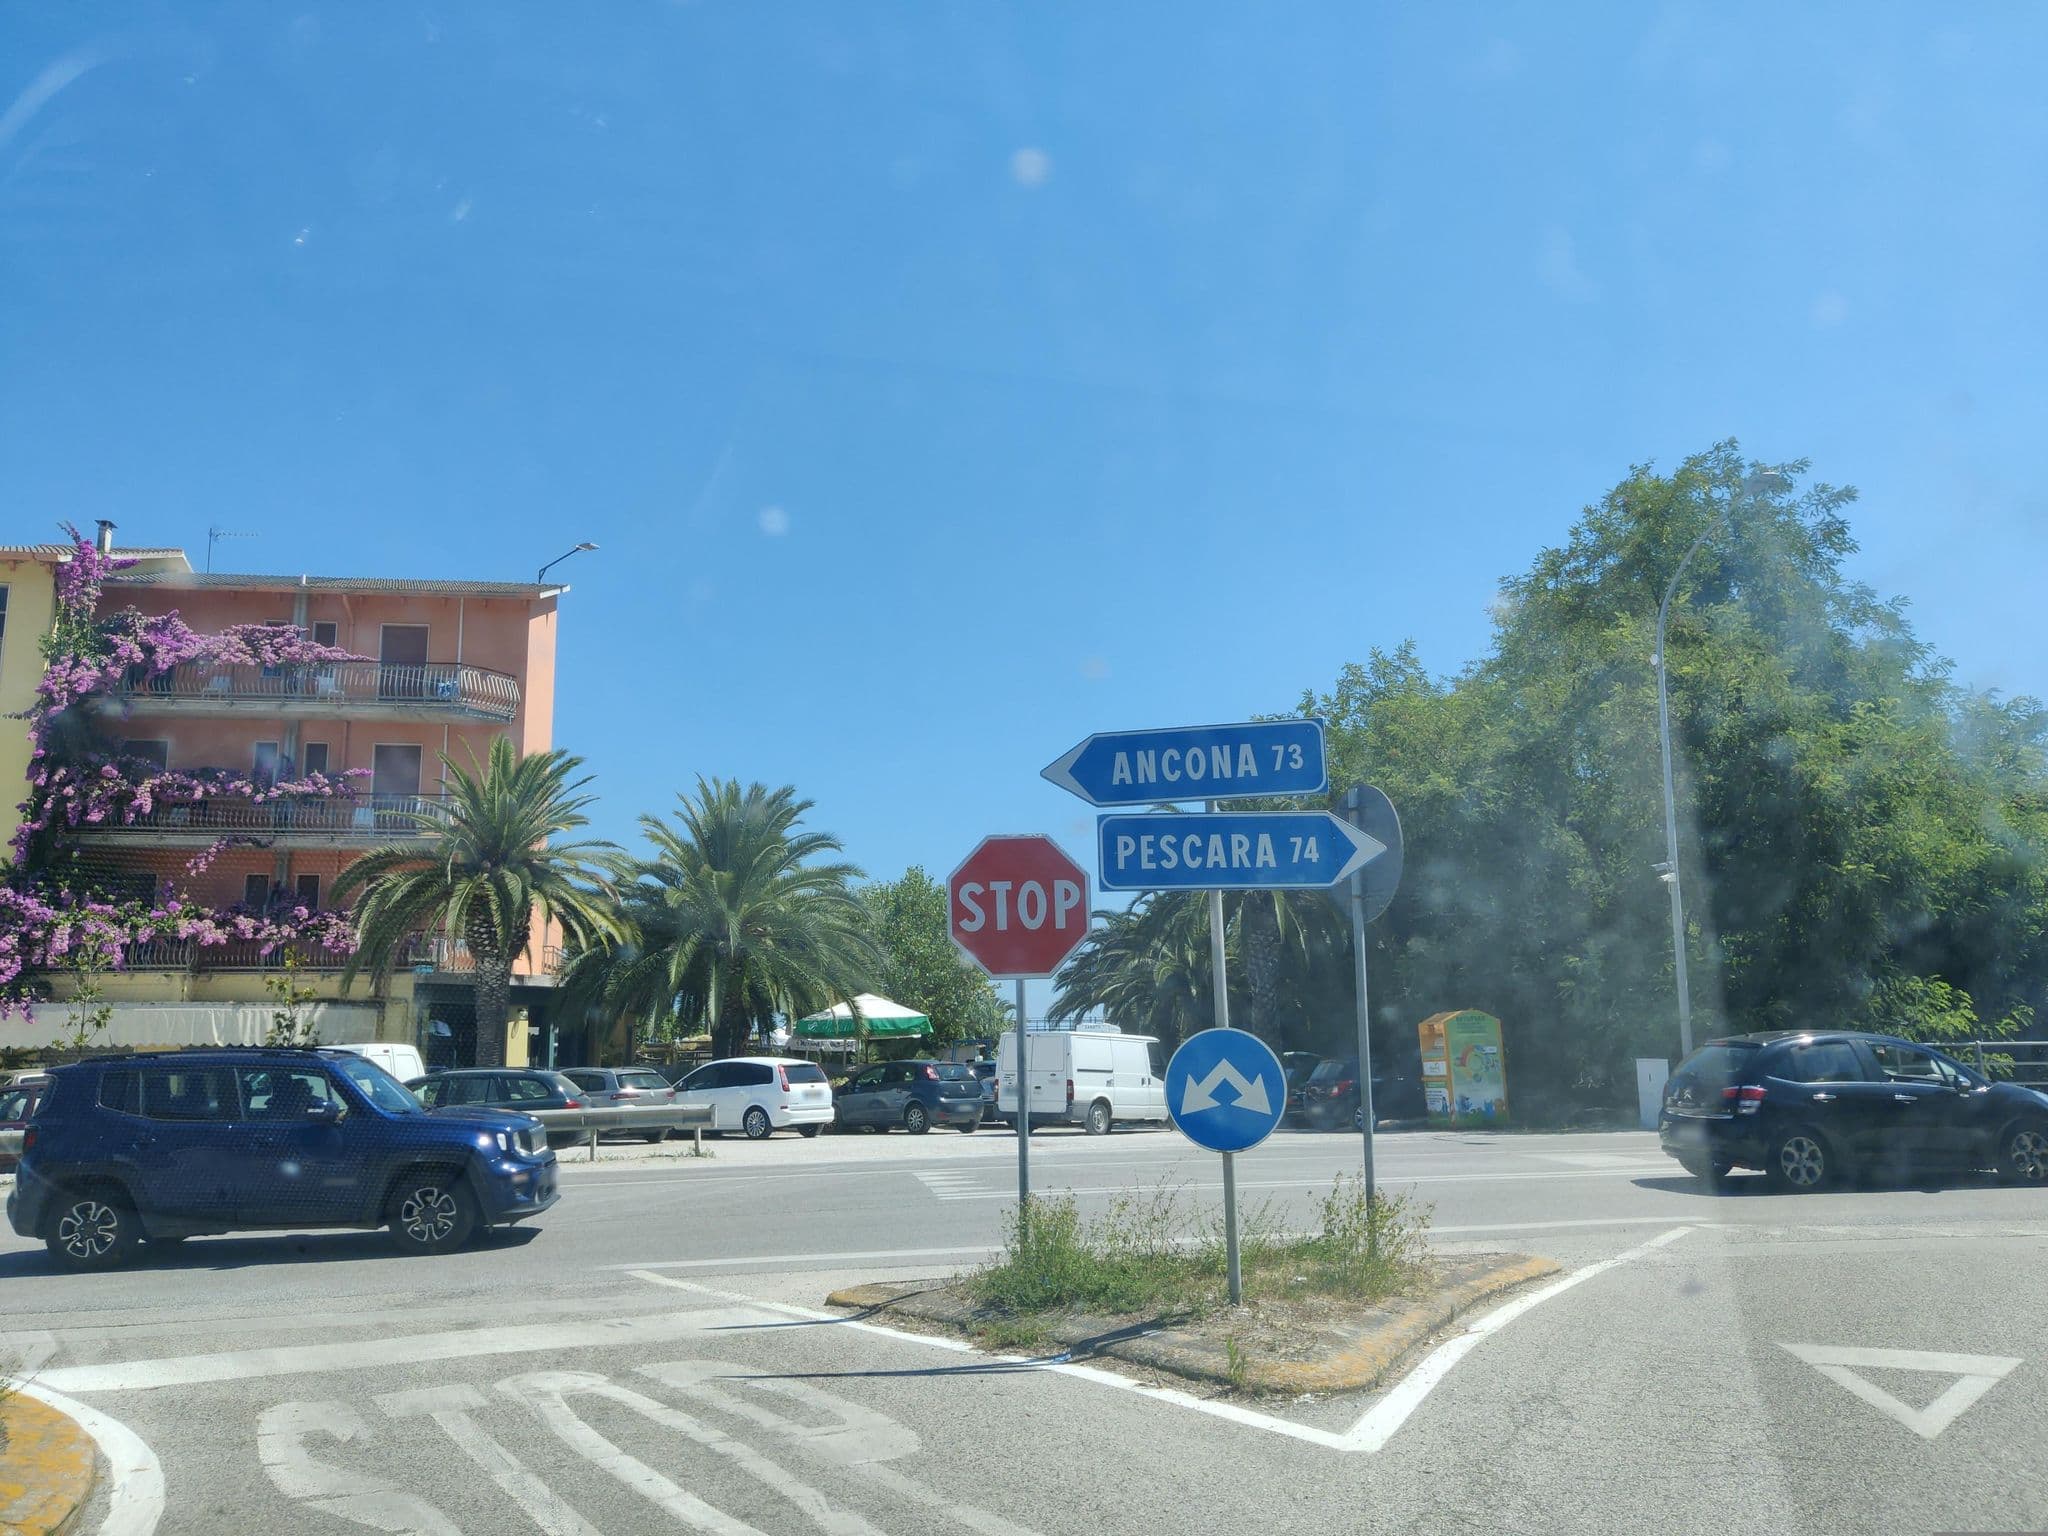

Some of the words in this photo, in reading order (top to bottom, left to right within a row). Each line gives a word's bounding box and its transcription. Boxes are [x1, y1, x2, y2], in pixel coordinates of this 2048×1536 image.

[1112, 743, 1258, 786] ANCONA
[1271, 743, 1304, 771] 73
[1117, 833, 1277, 870] PESCARA
[1289, 836, 1320, 863] 74
[958, 879, 1081, 933] STOP
[256, 1359, 1045, 1536] STOP
